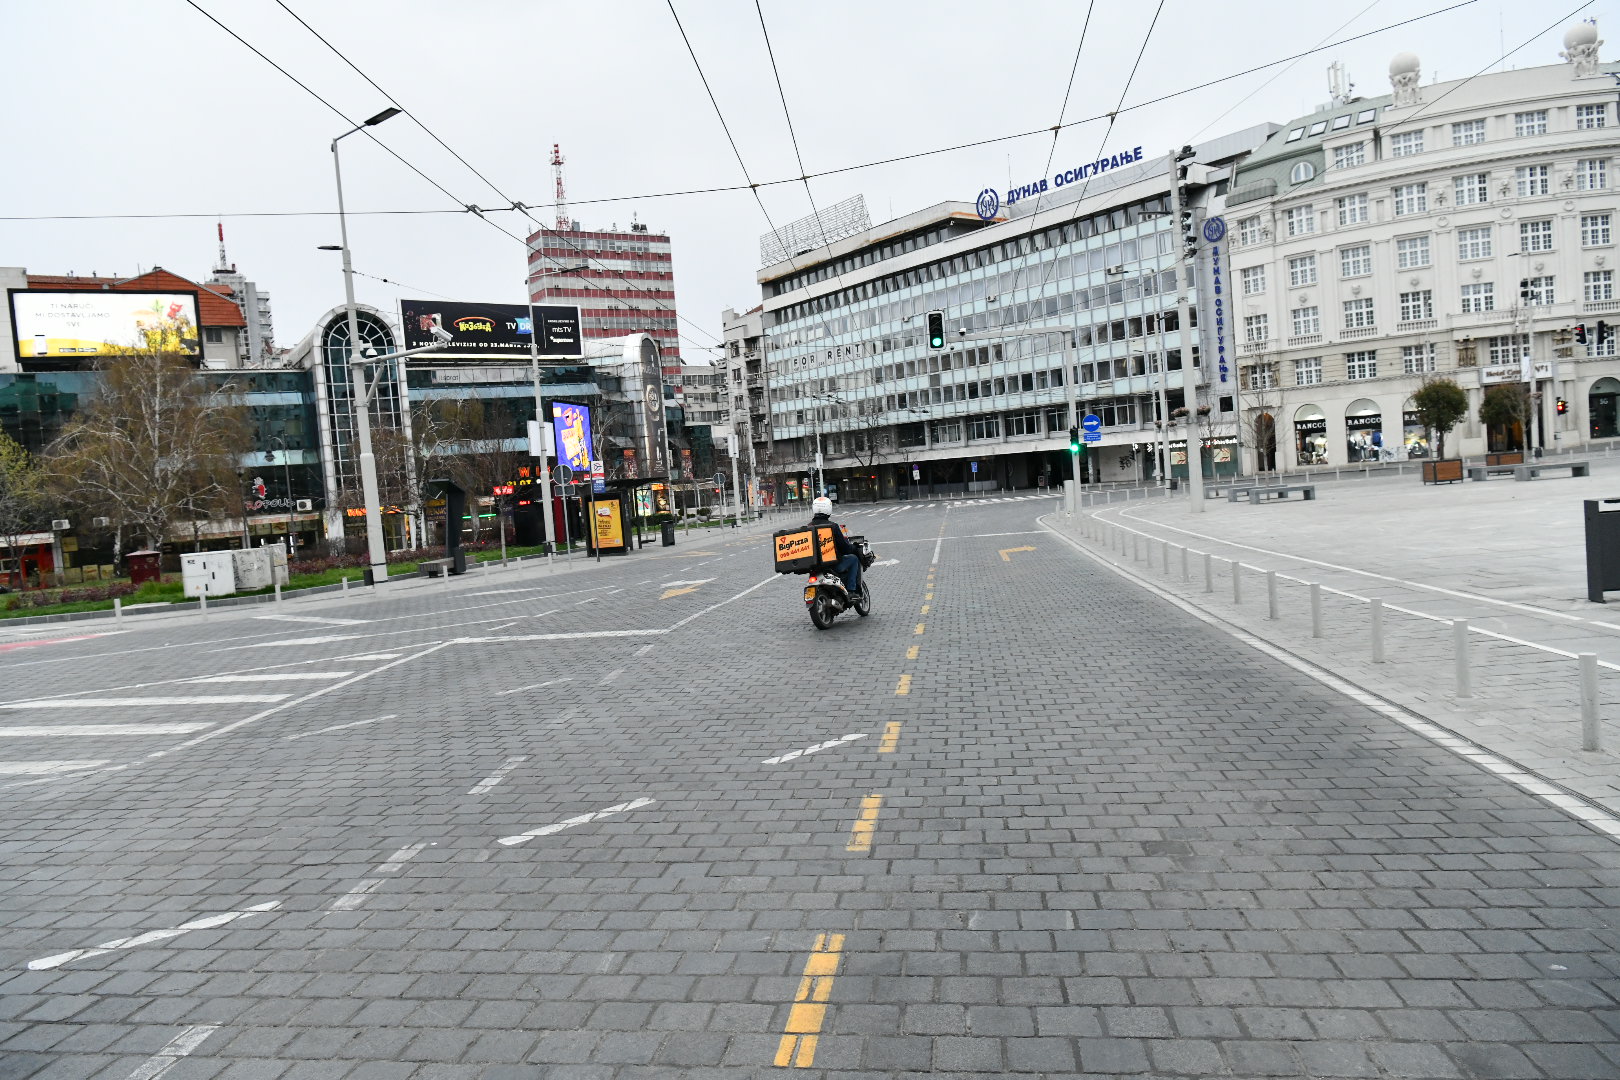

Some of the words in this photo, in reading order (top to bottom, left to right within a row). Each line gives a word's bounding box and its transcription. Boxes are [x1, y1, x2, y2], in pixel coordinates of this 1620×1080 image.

[1006, 178, 1048, 206] ДУНАВ
[1054, 146, 1143, 188] ОСИГУРАЊЕ
[1212, 246, 1222, 295] ДУНАВ
[505, 322, 517, 330] TV
[1215, 298, 1228, 383] ОСИГУРАЊЕ
[793, 355, 815, 366] FOR
[827, 343, 860, 360] RENT
[778, 537, 809, 551] BigPizza
